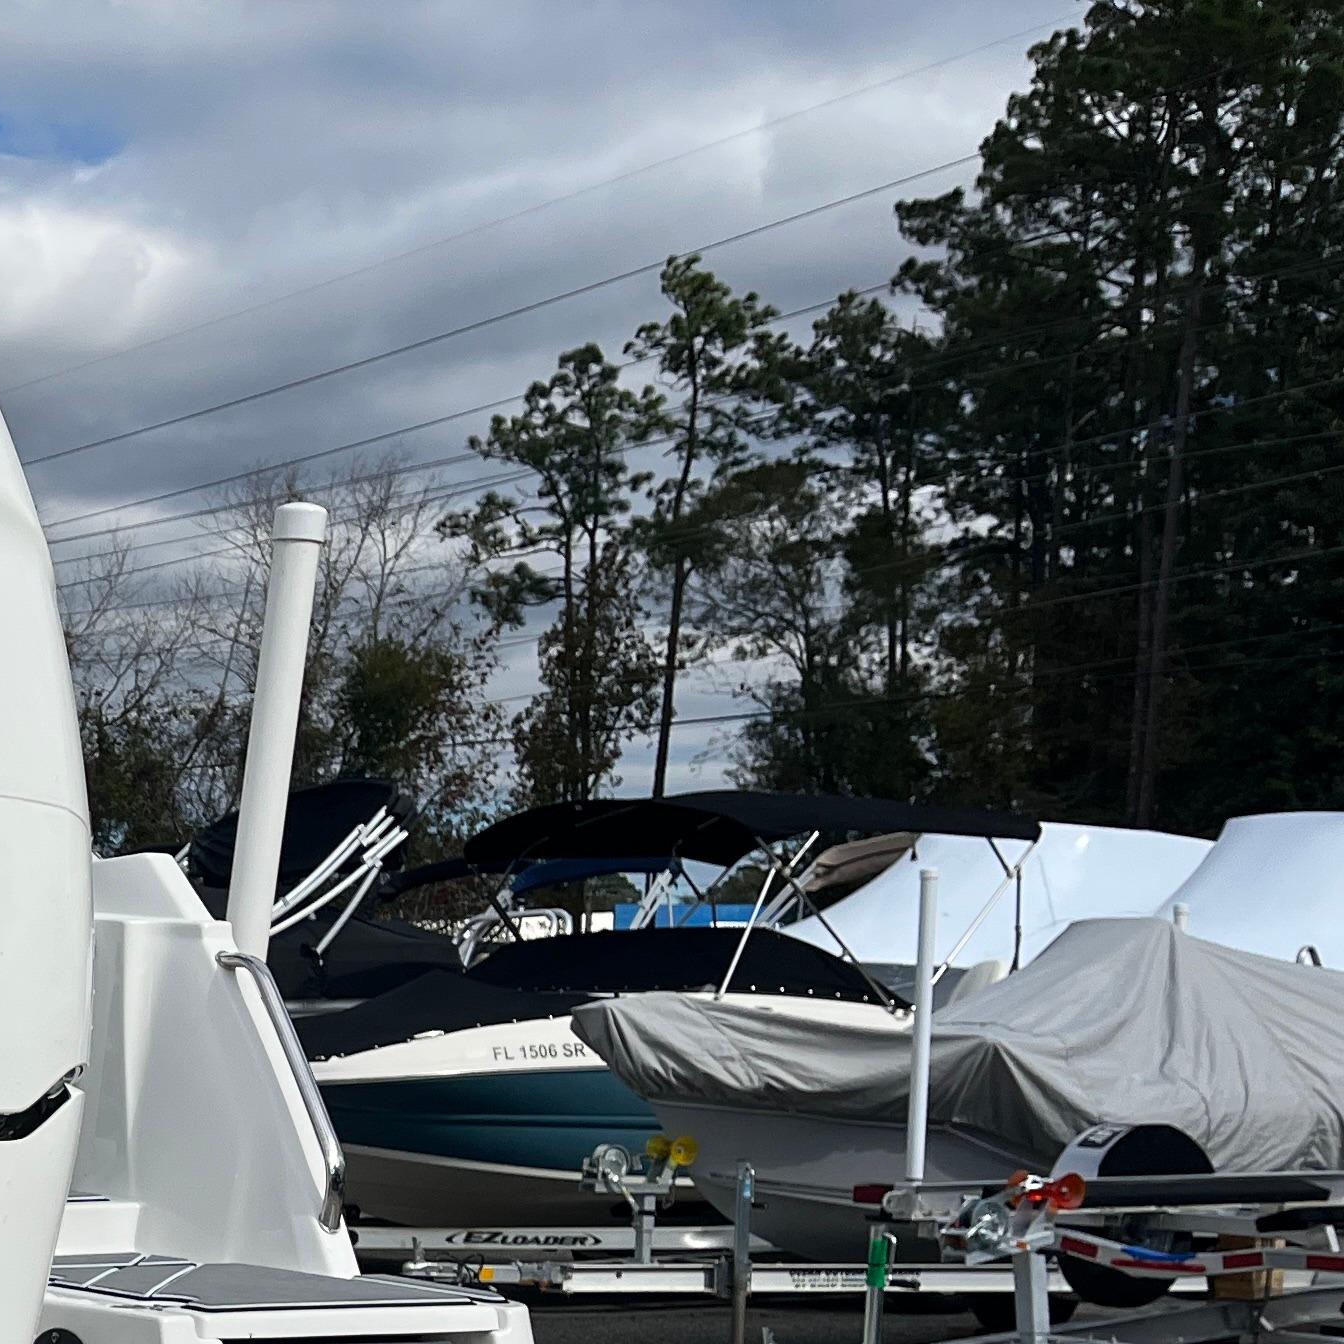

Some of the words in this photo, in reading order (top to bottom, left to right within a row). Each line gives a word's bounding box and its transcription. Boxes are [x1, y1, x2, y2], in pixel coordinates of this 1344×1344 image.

[492, 1046, 515, 1060] FL
[519, 1043, 558, 1060] 1506
[562, 1042, 587, 1058] SR
[463, 1231, 590, 1246] EZLOADER
